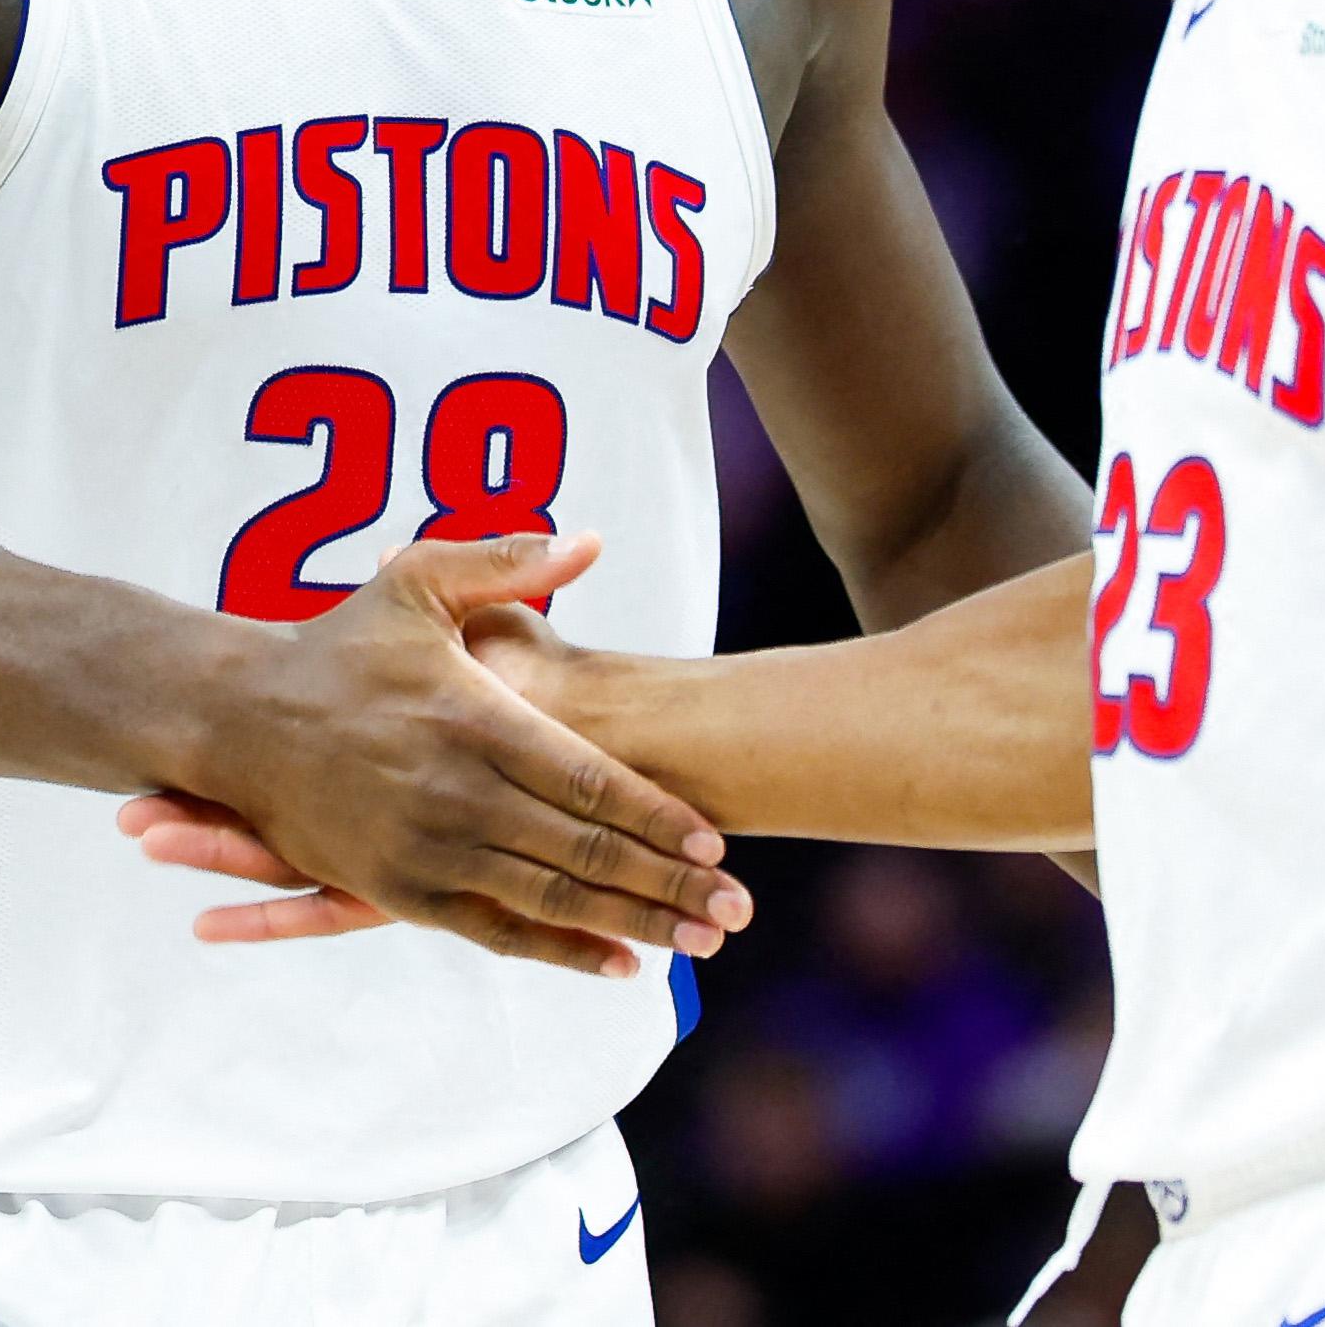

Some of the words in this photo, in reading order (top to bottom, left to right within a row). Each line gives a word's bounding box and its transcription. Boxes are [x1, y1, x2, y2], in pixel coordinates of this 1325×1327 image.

[102, 114, 706, 345] PISTONS
[216, 364, 568, 623] 28
[1092, 451, 1226, 760] 23
